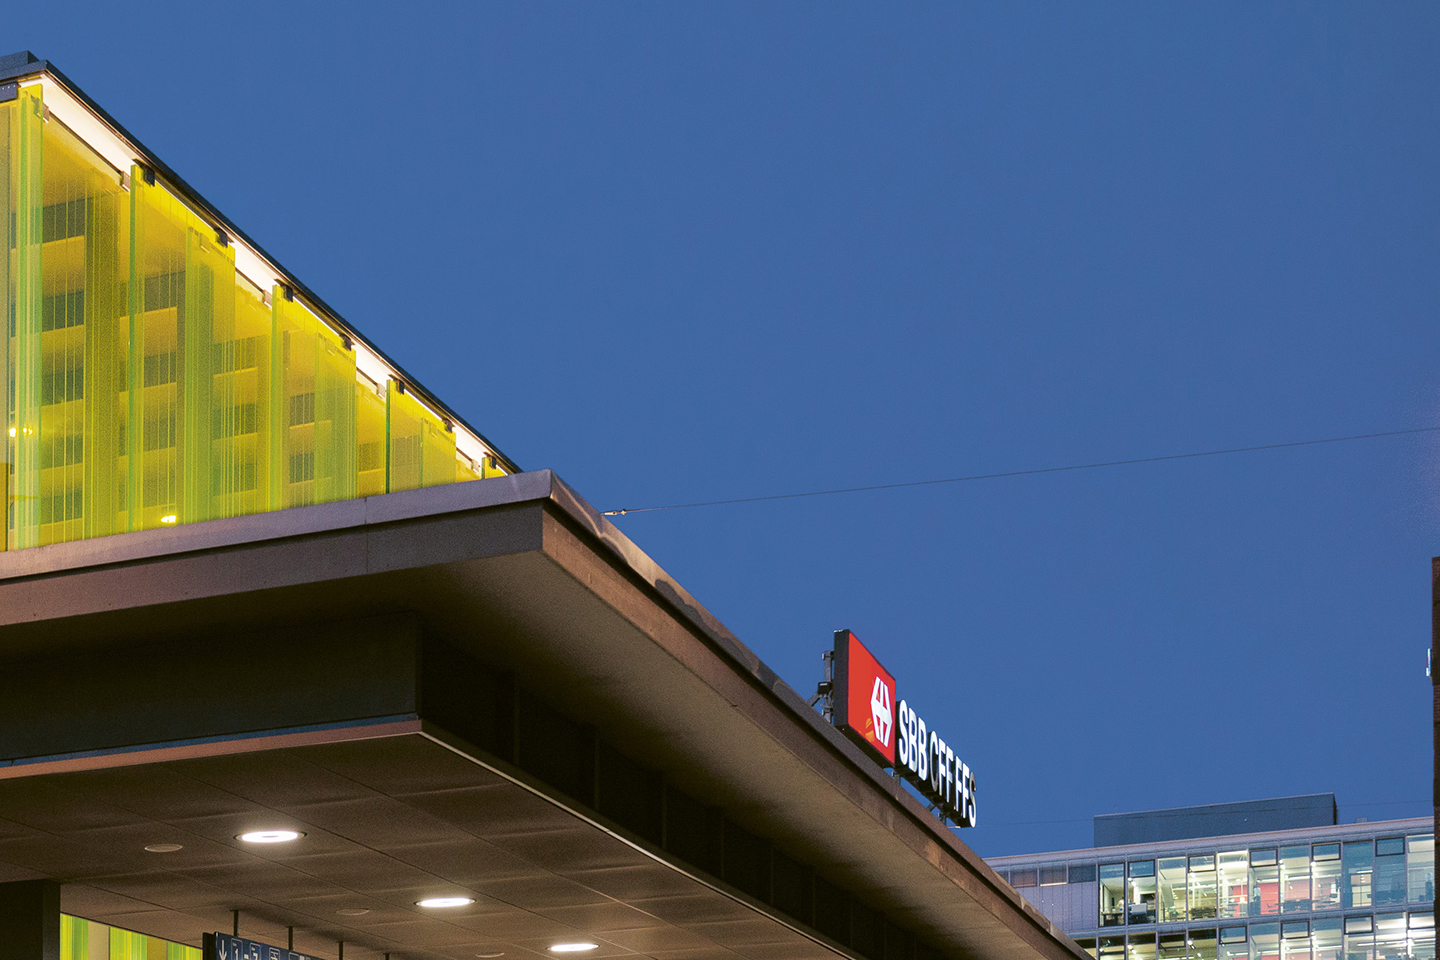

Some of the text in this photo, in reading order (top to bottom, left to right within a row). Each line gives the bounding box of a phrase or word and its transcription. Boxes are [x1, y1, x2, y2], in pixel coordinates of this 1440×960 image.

[898, 700, 976, 828] SBB CFF FFS
